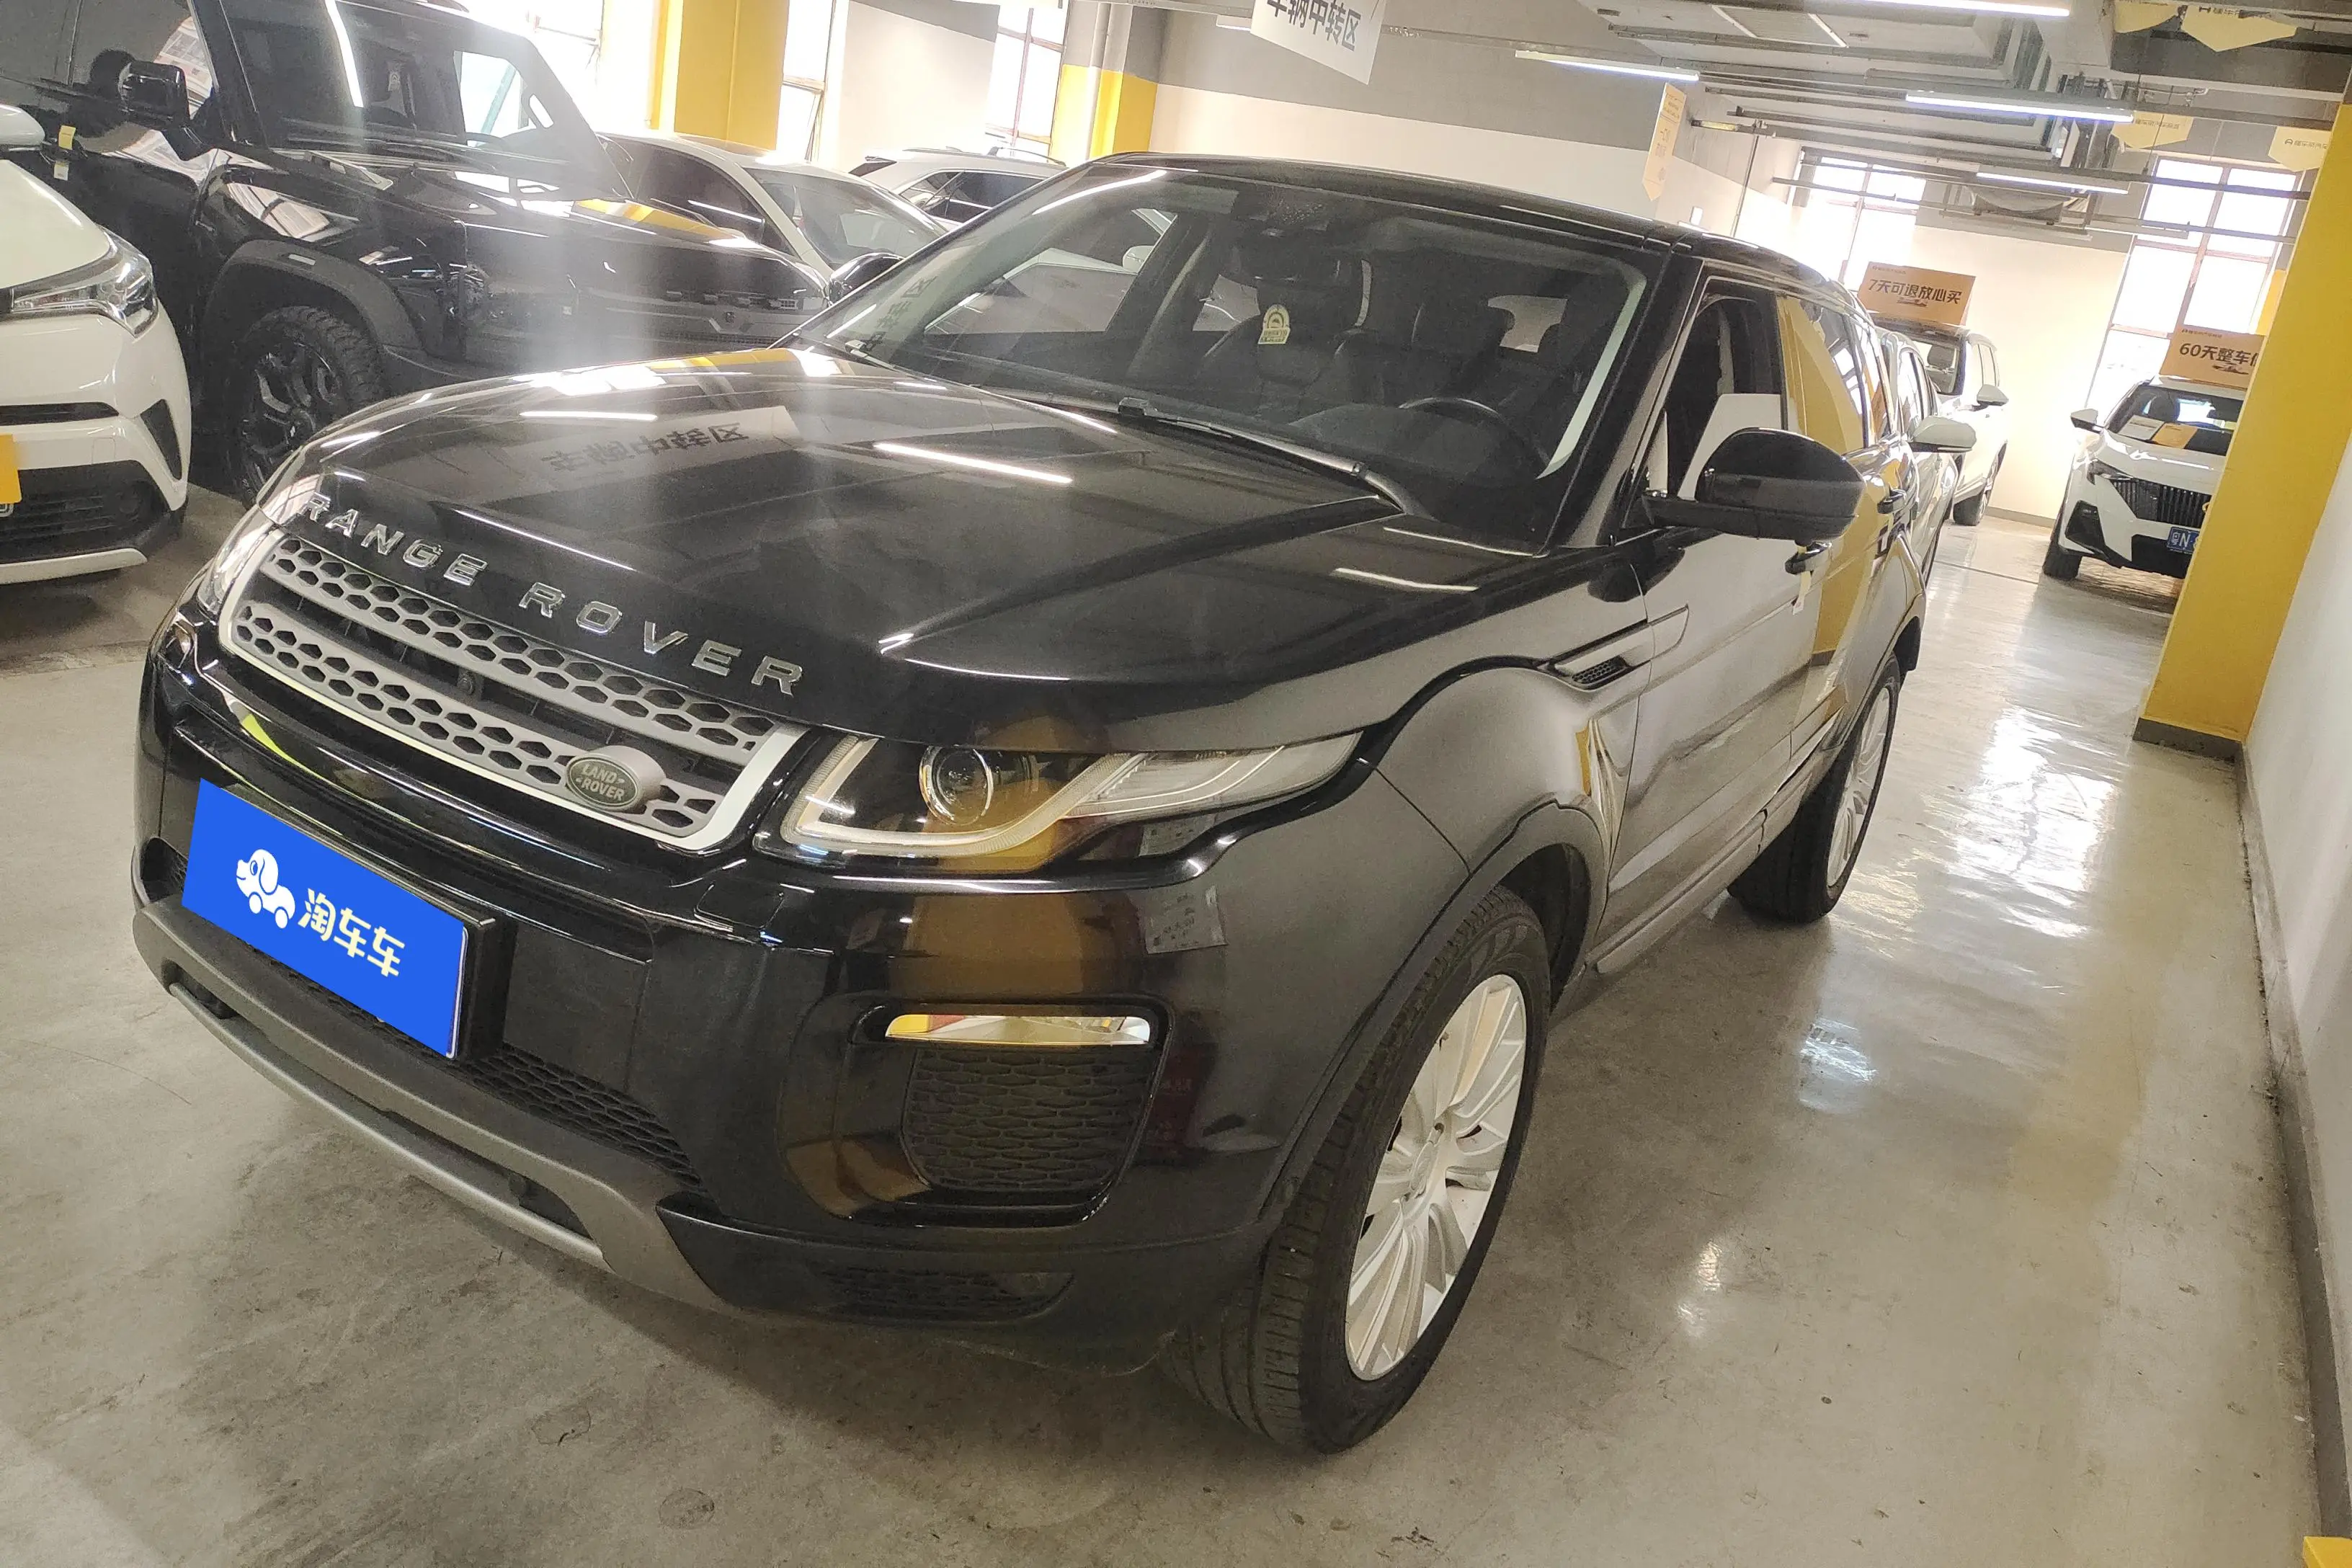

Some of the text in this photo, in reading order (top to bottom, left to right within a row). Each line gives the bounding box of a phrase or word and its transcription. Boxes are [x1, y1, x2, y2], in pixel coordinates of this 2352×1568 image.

[1868, 279, 1962, 304] 7天可退放心买
[306, 491, 803, 696] RANGE ROVER
[582, 764, 618, 783] LAND
[582, 778, 625, 801] ROVER
